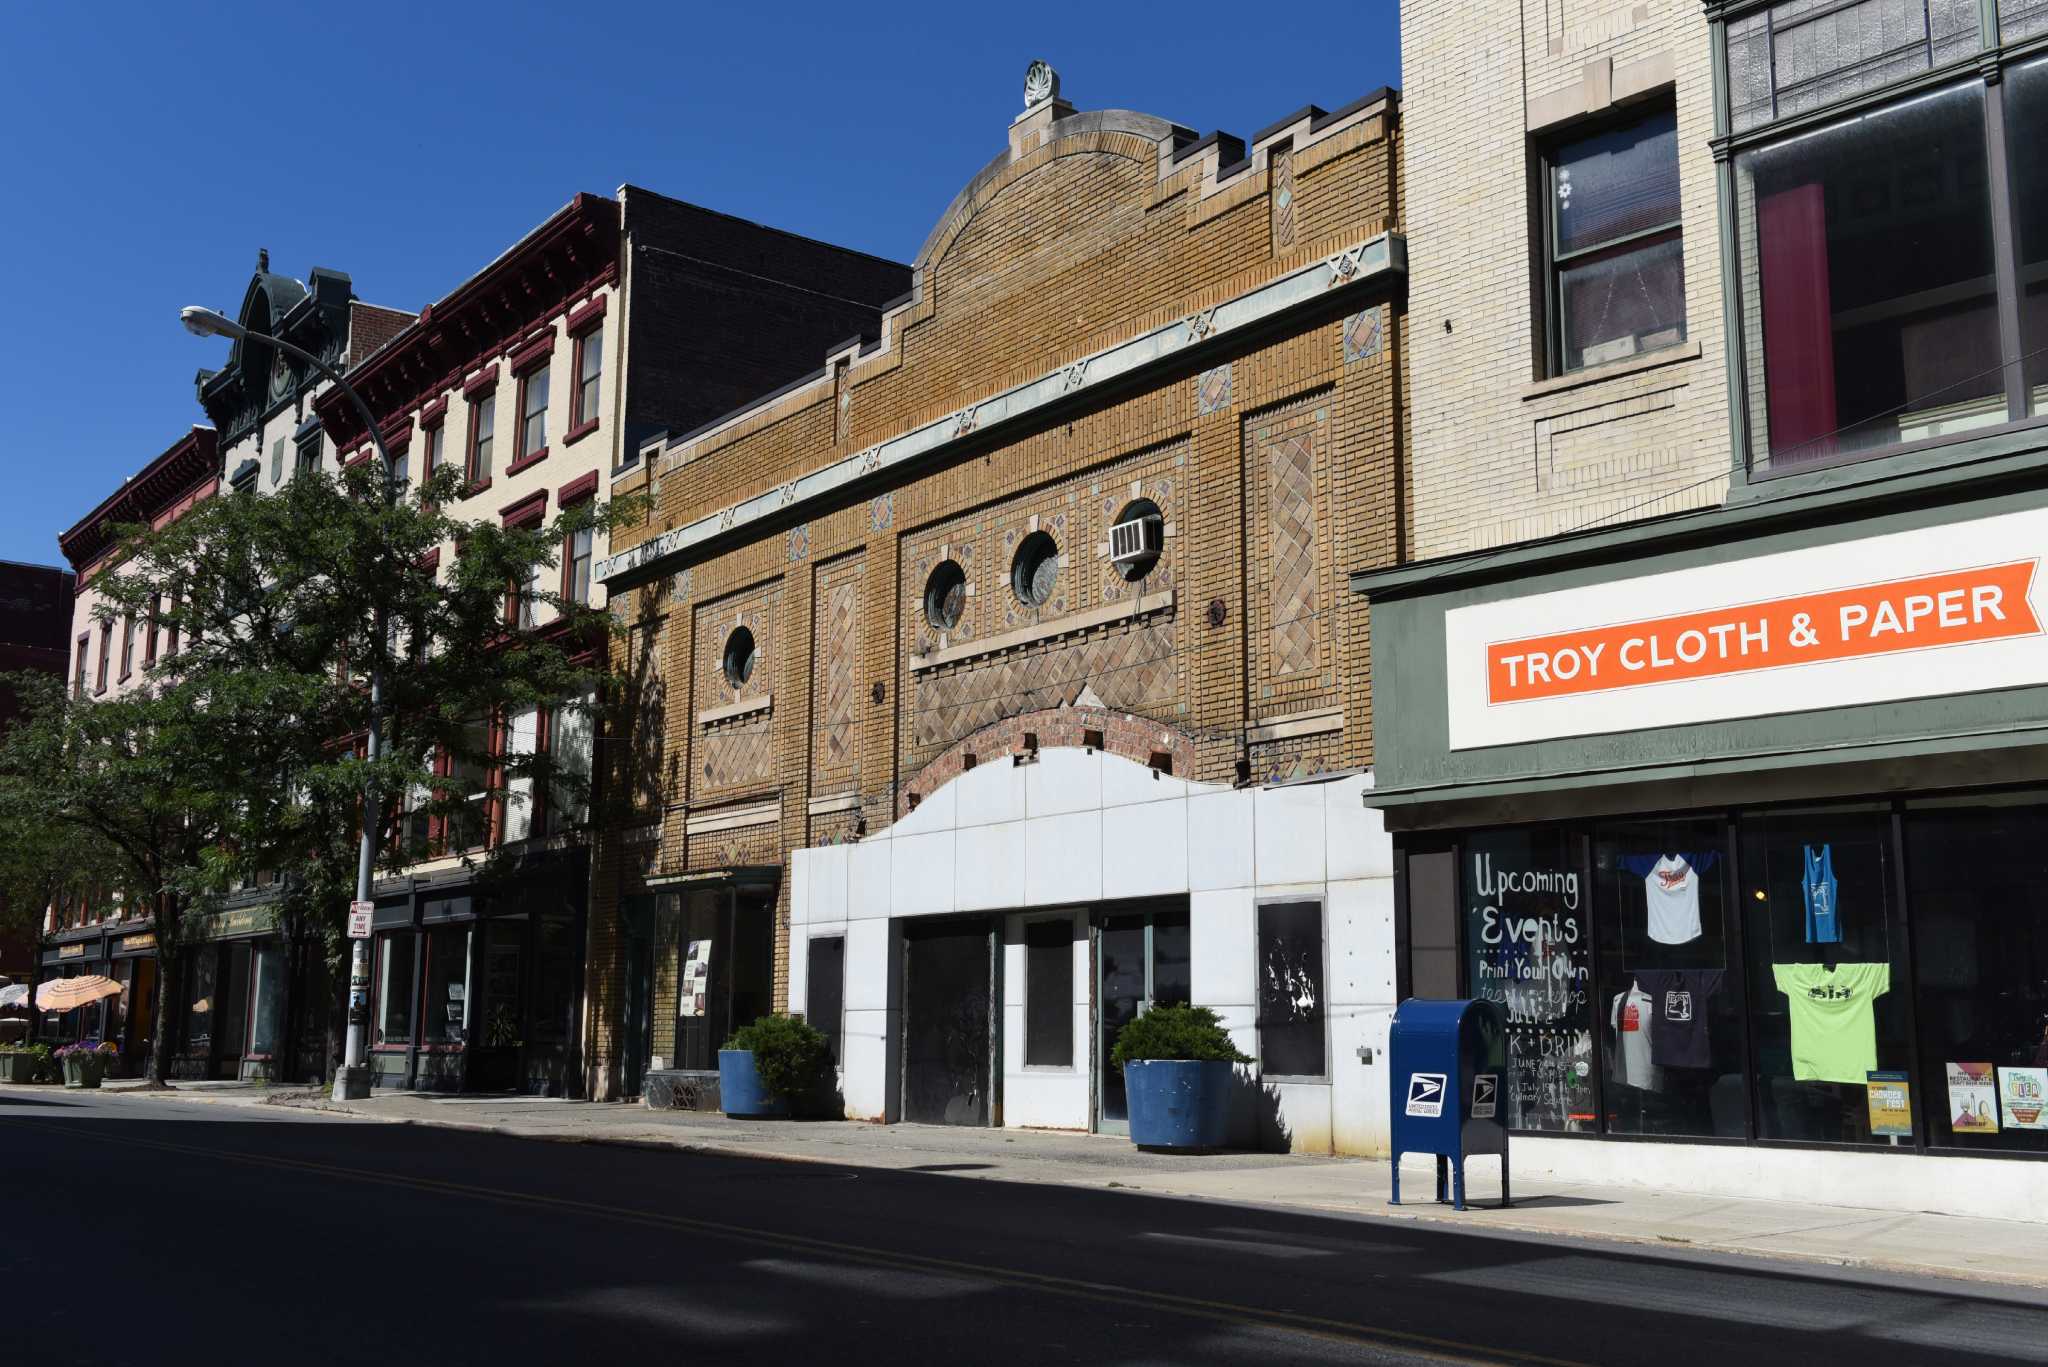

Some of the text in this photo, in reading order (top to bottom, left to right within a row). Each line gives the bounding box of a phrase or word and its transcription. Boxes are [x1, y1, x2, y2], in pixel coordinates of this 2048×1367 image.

[1500, 584, 2007, 687] TROY CLOTH & PAPER
[1475, 852, 1579, 910] Upcoming
[1481, 905, 1578, 944] Events
[1479, 959, 1508, 979] Print
